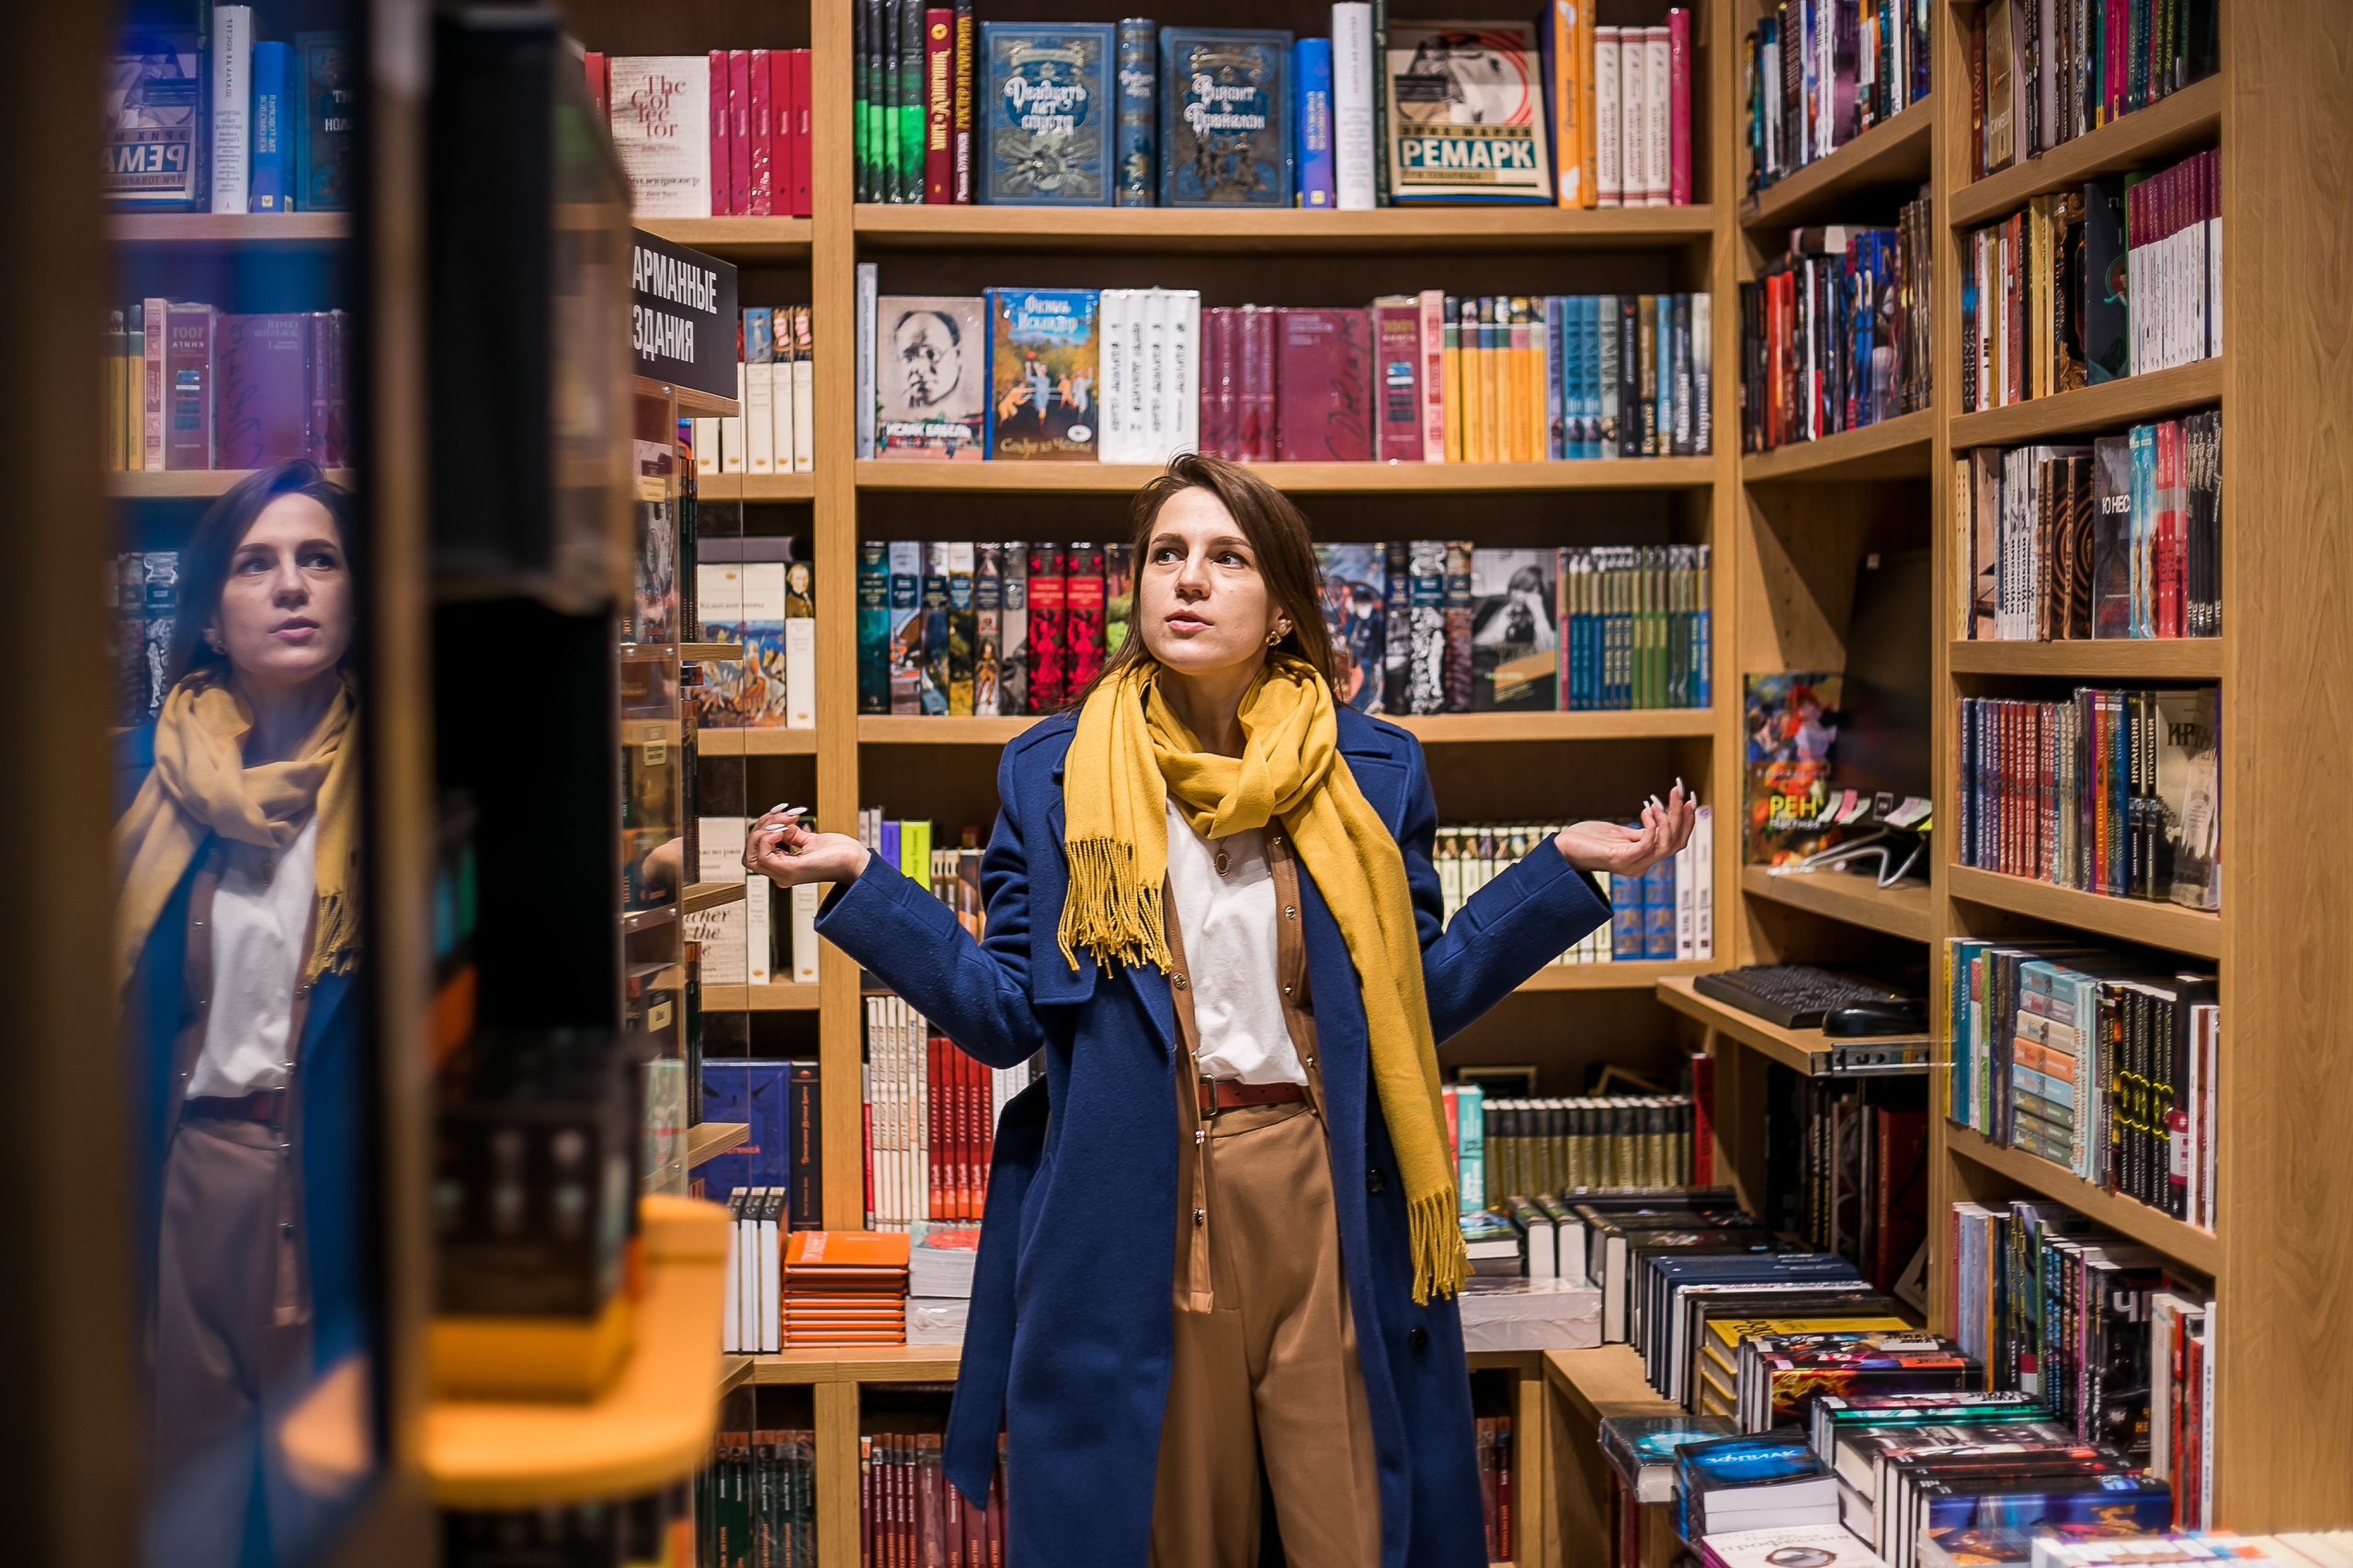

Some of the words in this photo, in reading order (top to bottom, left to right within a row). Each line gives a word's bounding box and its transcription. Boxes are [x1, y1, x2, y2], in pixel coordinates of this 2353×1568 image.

[643, 74, 686, 97] The
[631, 89, 671, 110] Col
[646, 119, 678, 139] tor
[1403, 140, 1534, 167] РЕМАРК
[632, 245, 717, 314] АРМАННЫЕ
[632, 304, 695, 363] ЗДАНИЯ
[693, 923, 721, 939] the
